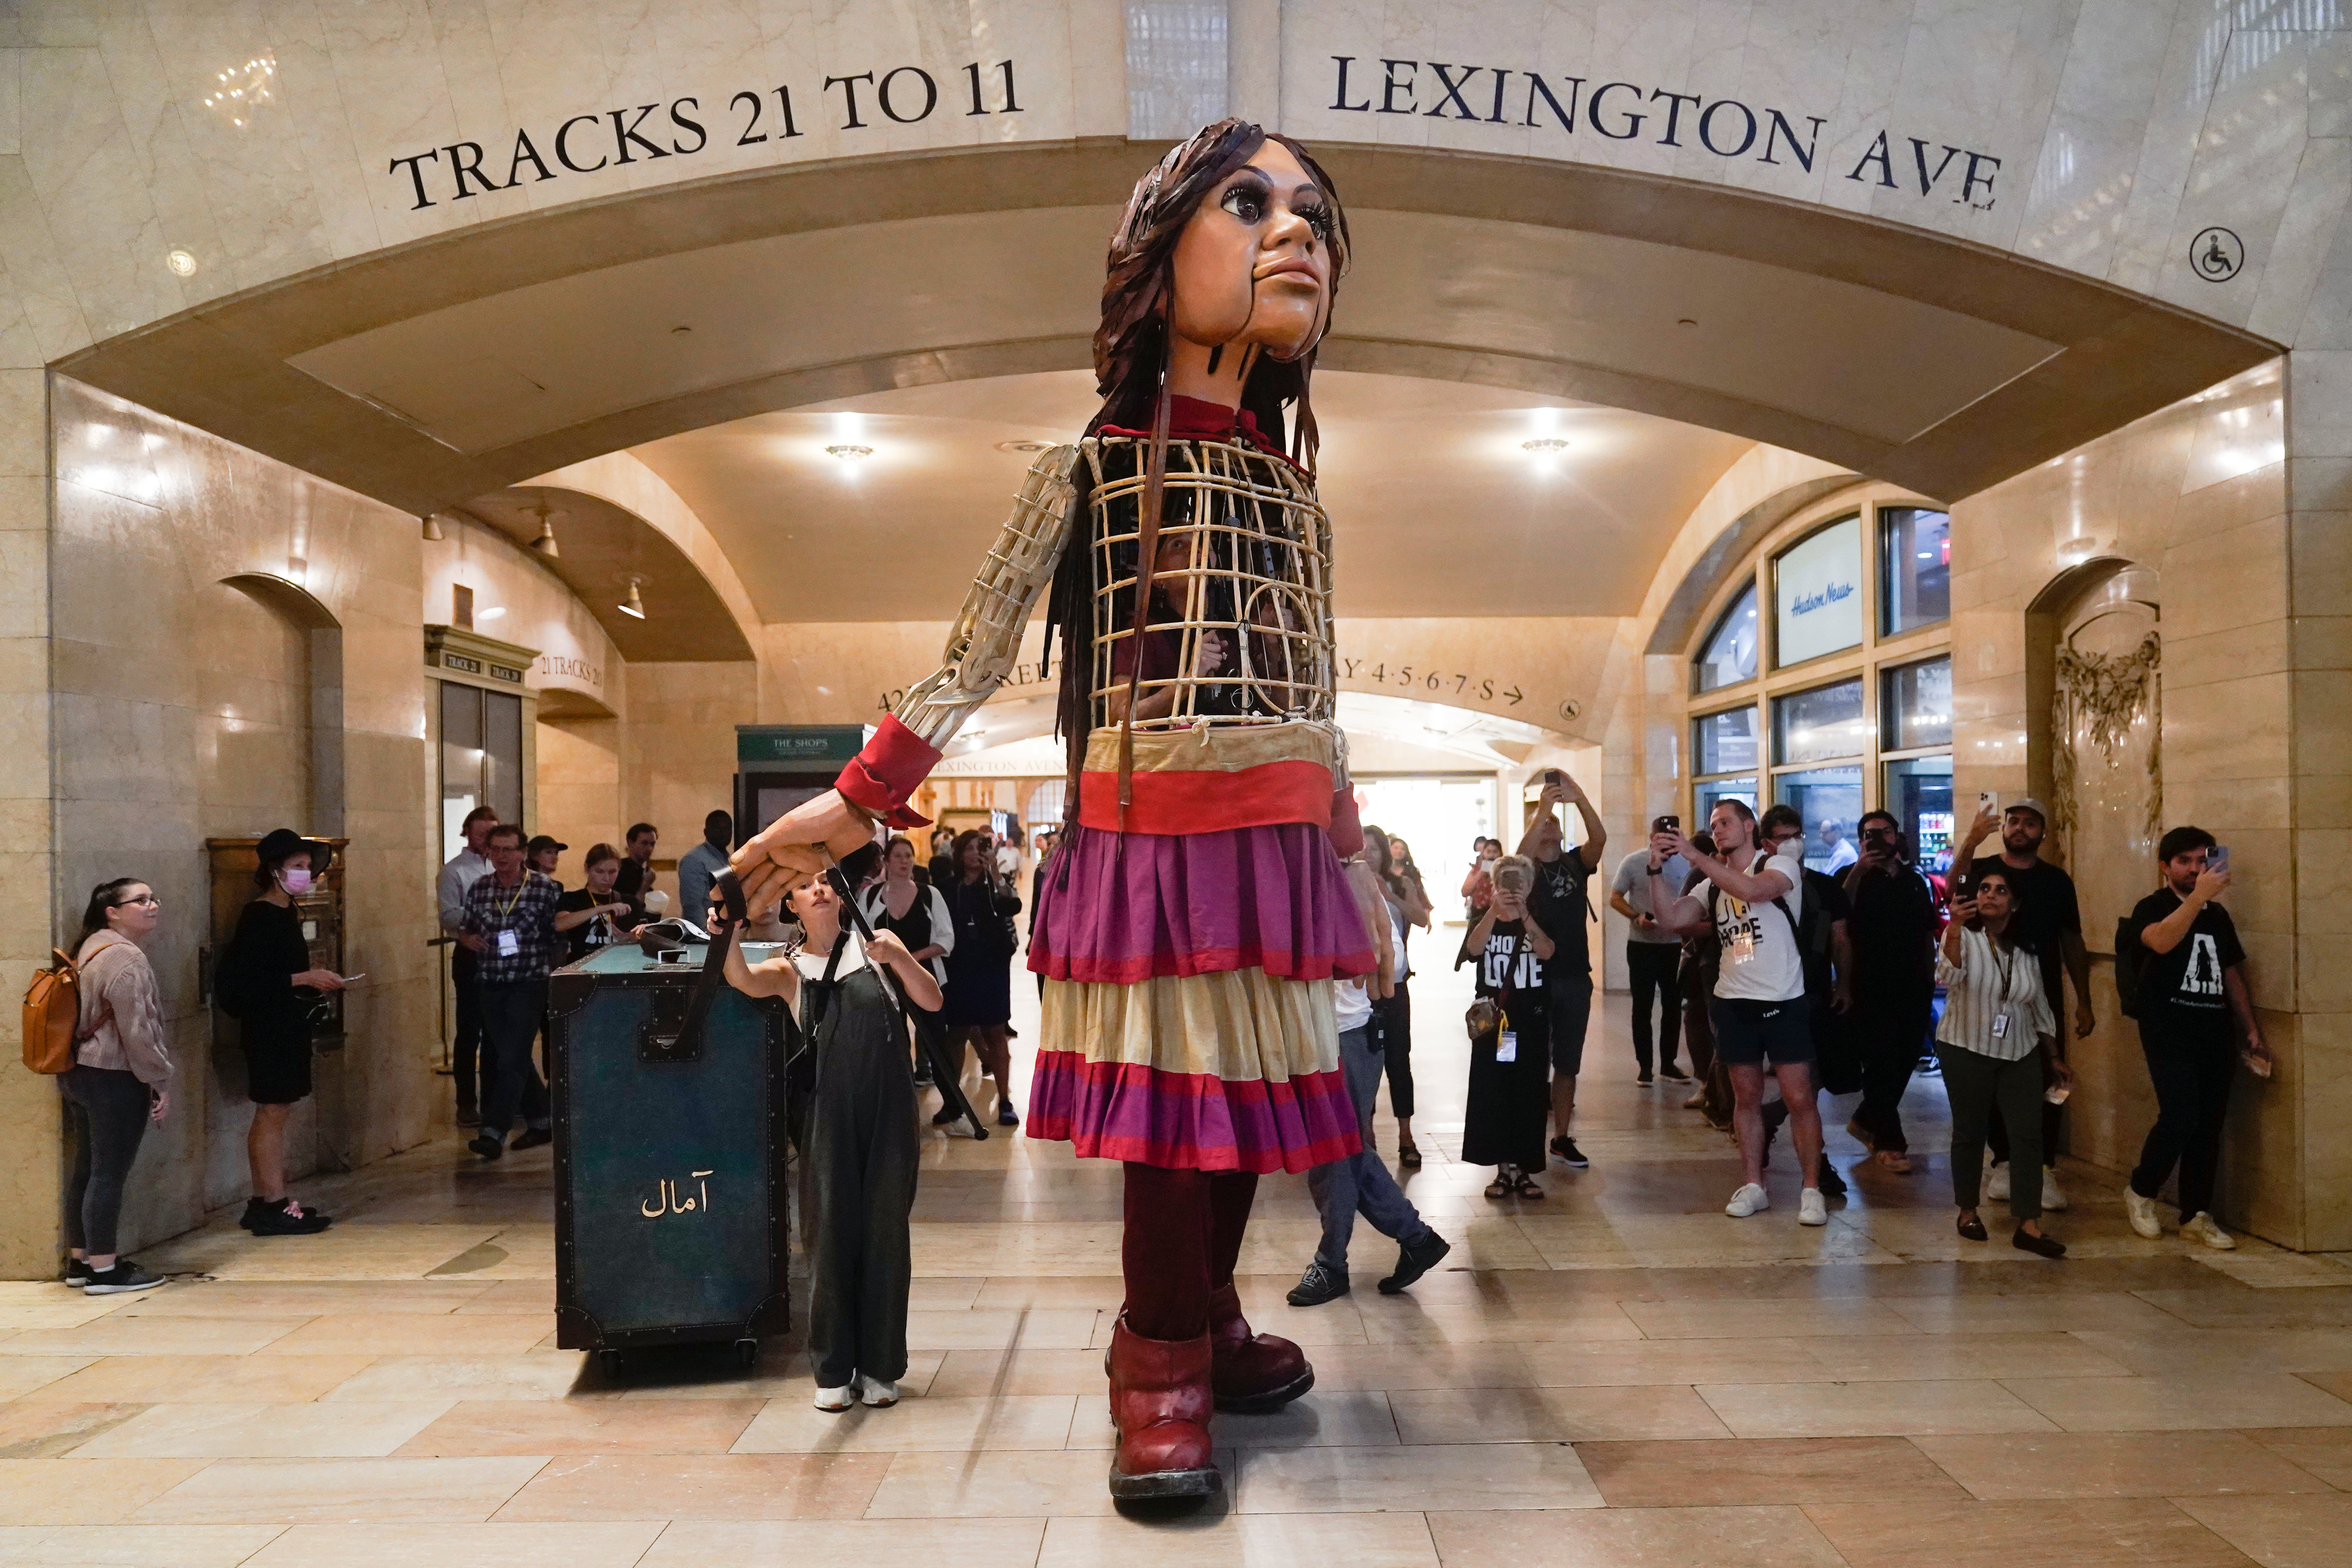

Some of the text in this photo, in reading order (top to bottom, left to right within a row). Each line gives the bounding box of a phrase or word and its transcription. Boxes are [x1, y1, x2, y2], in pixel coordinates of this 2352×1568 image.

[389, 59, 1025, 211] TRACKS 21 TO 11
[1329, 56, 2001, 211] LEXINGTON AVE
[1791, 581, 1854, 618] Hudson News
[543, 657, 550, 675] 21
[553, 657, 591, 682] TRACKS
[774, 738, 828, 748] THE SHOPS
[1484, 952, 1543, 989] LOVE
[642, 1170, 713, 1217] آمال
